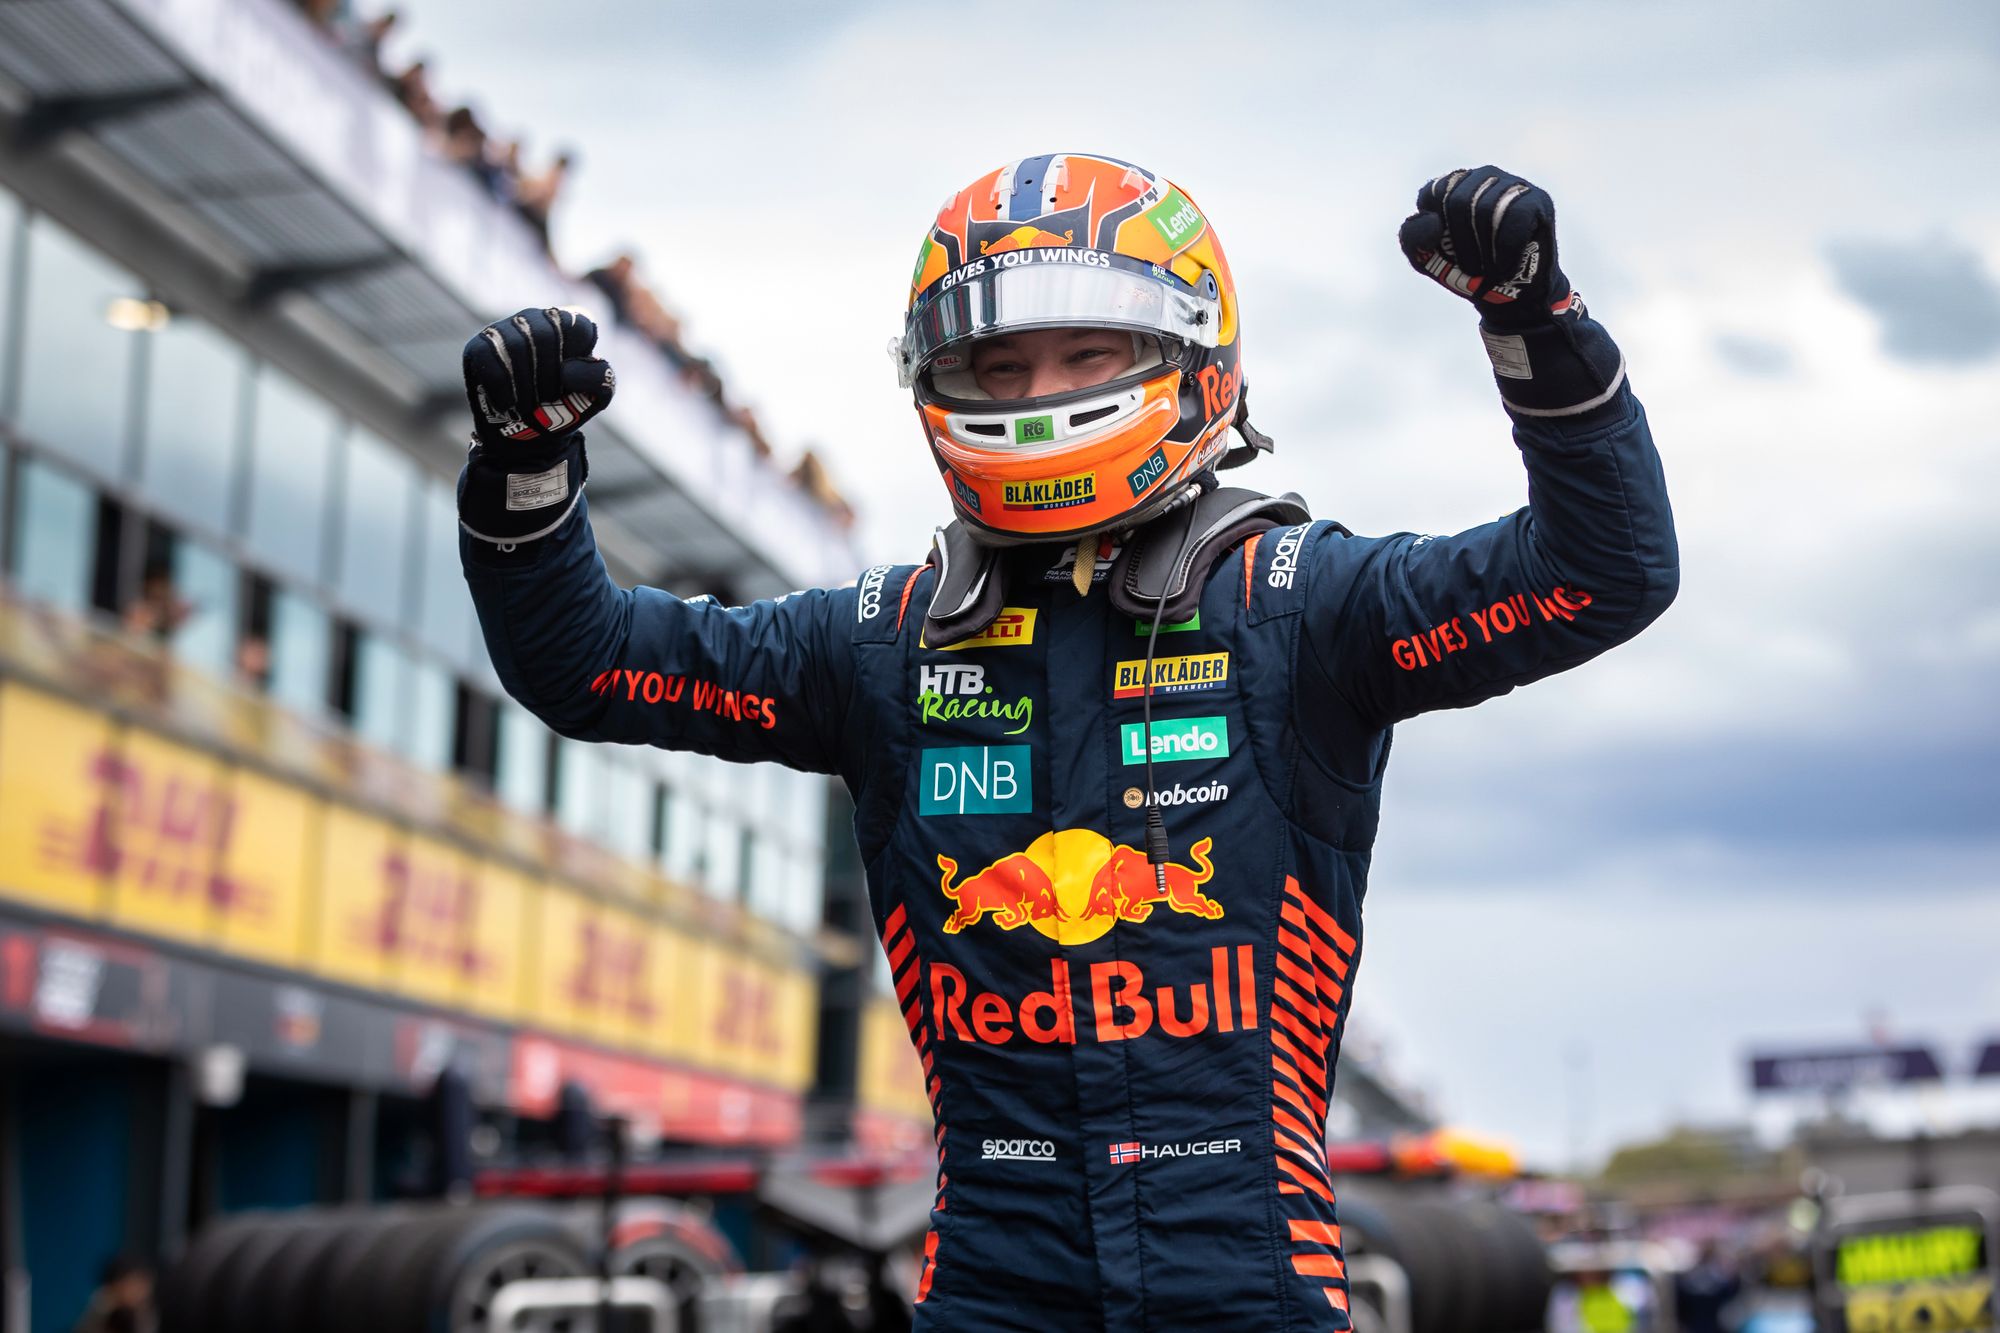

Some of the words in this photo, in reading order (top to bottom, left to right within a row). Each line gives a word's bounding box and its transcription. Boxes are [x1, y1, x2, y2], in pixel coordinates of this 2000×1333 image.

[941, 259, 985, 292] GIVES
[991, 249, 1034, 269] YOU
[1039, 248, 1111, 268] WINGS
[1196, 335, 1242, 423] Red
[1023, 421, 1045, 437] RG
[1005, 477, 1094, 503] BLÅKLÄDER
[1133, 456, 1165, 490] DNB
[1043, 498, 1087, 509] WORKWEAR
[1392, 617, 1468, 671] GIVES
[1469, 593, 1531, 644] YOU
[624, 669, 687, 704] YOU
[693, 679, 776, 729] WINGS
[1165, 682, 1214, 693] WORKWEAR
[917, 688, 1033, 735] Racing
[1131, 725, 1218, 757] Lendo
[934, 746, 1018, 815] DNB
[929, 958, 1077, 1046] Red
[1090, 944, 1259, 1043] Bull
[981, 1138, 1057, 1161] sparco
[1141, 1138, 1241, 1158] HAUGER
